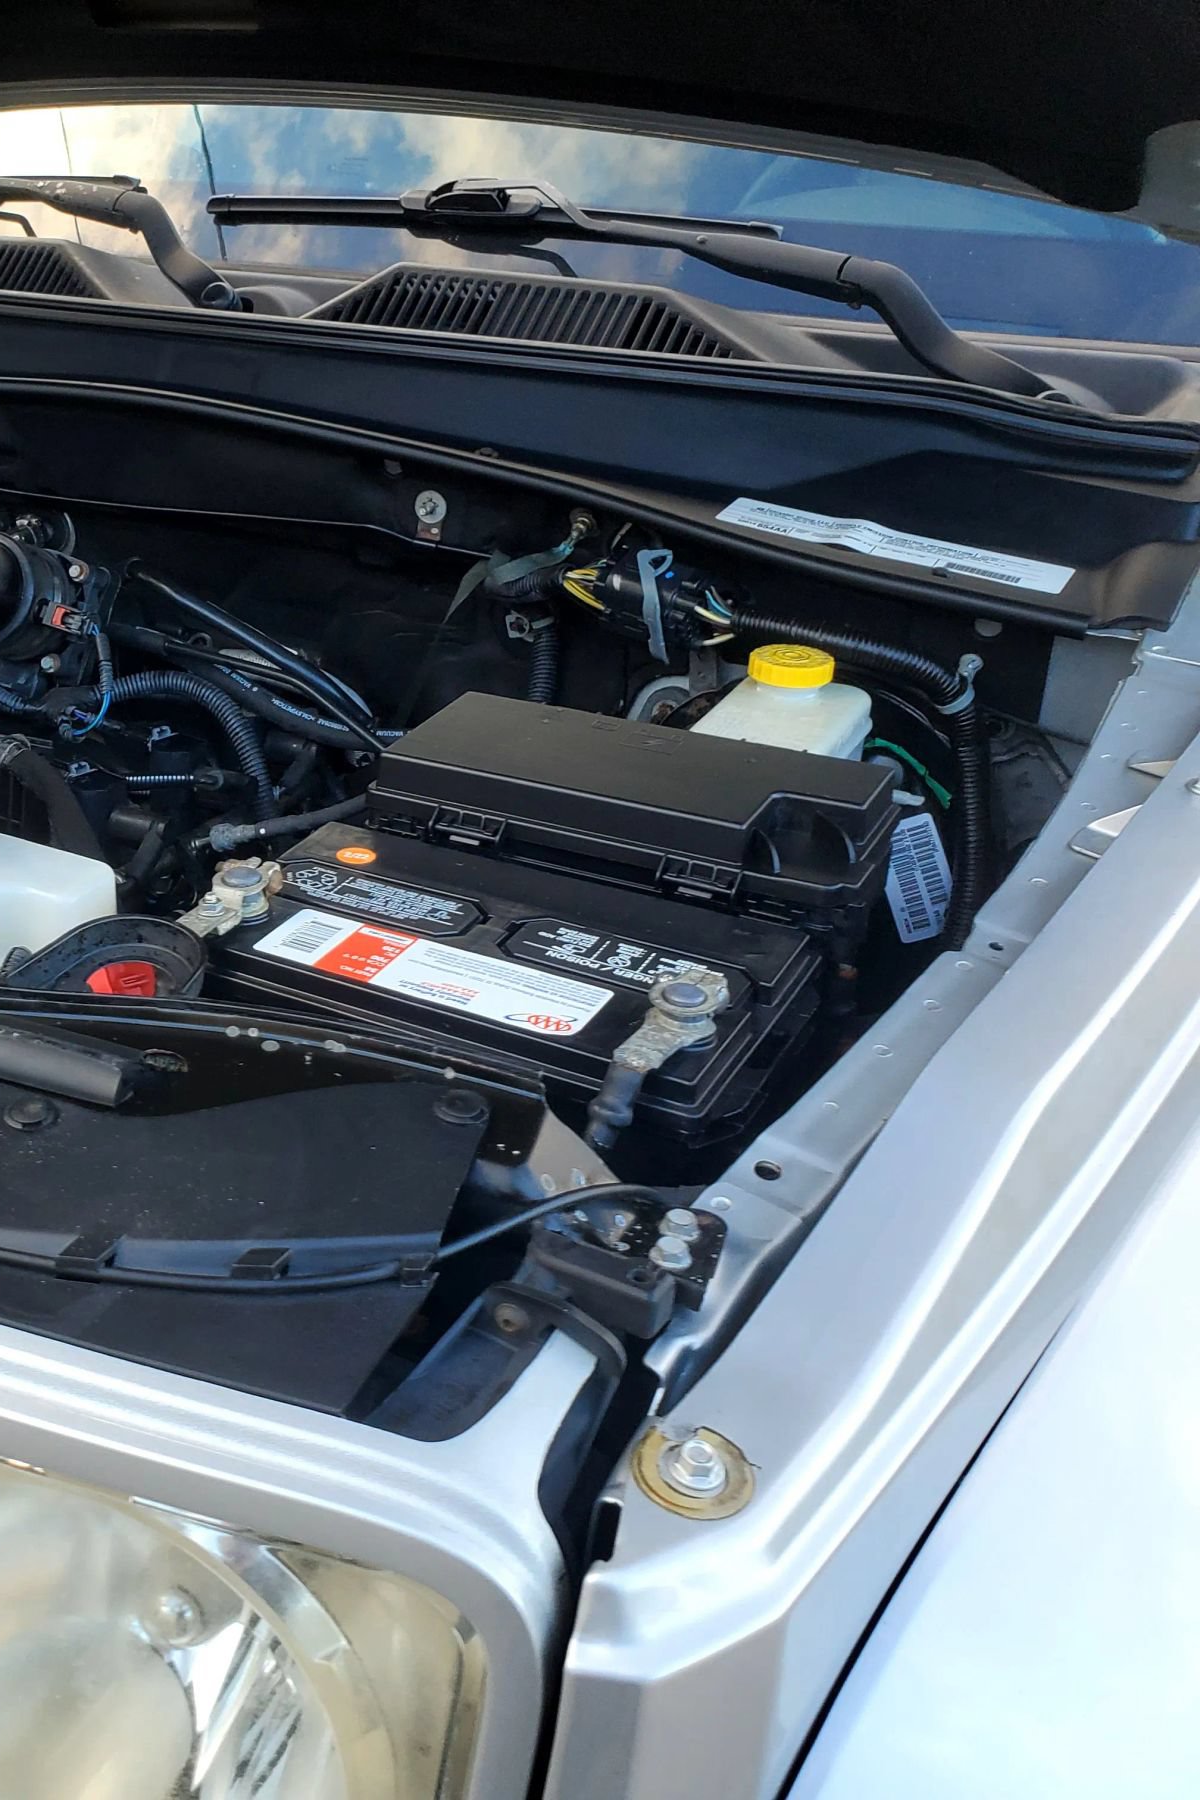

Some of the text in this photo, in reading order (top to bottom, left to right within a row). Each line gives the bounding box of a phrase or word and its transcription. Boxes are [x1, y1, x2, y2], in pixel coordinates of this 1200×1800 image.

[544, 949, 601, 970] POISON
[613, 967, 655, 984] NGER
[527, 1013, 573, 1032] AAA
